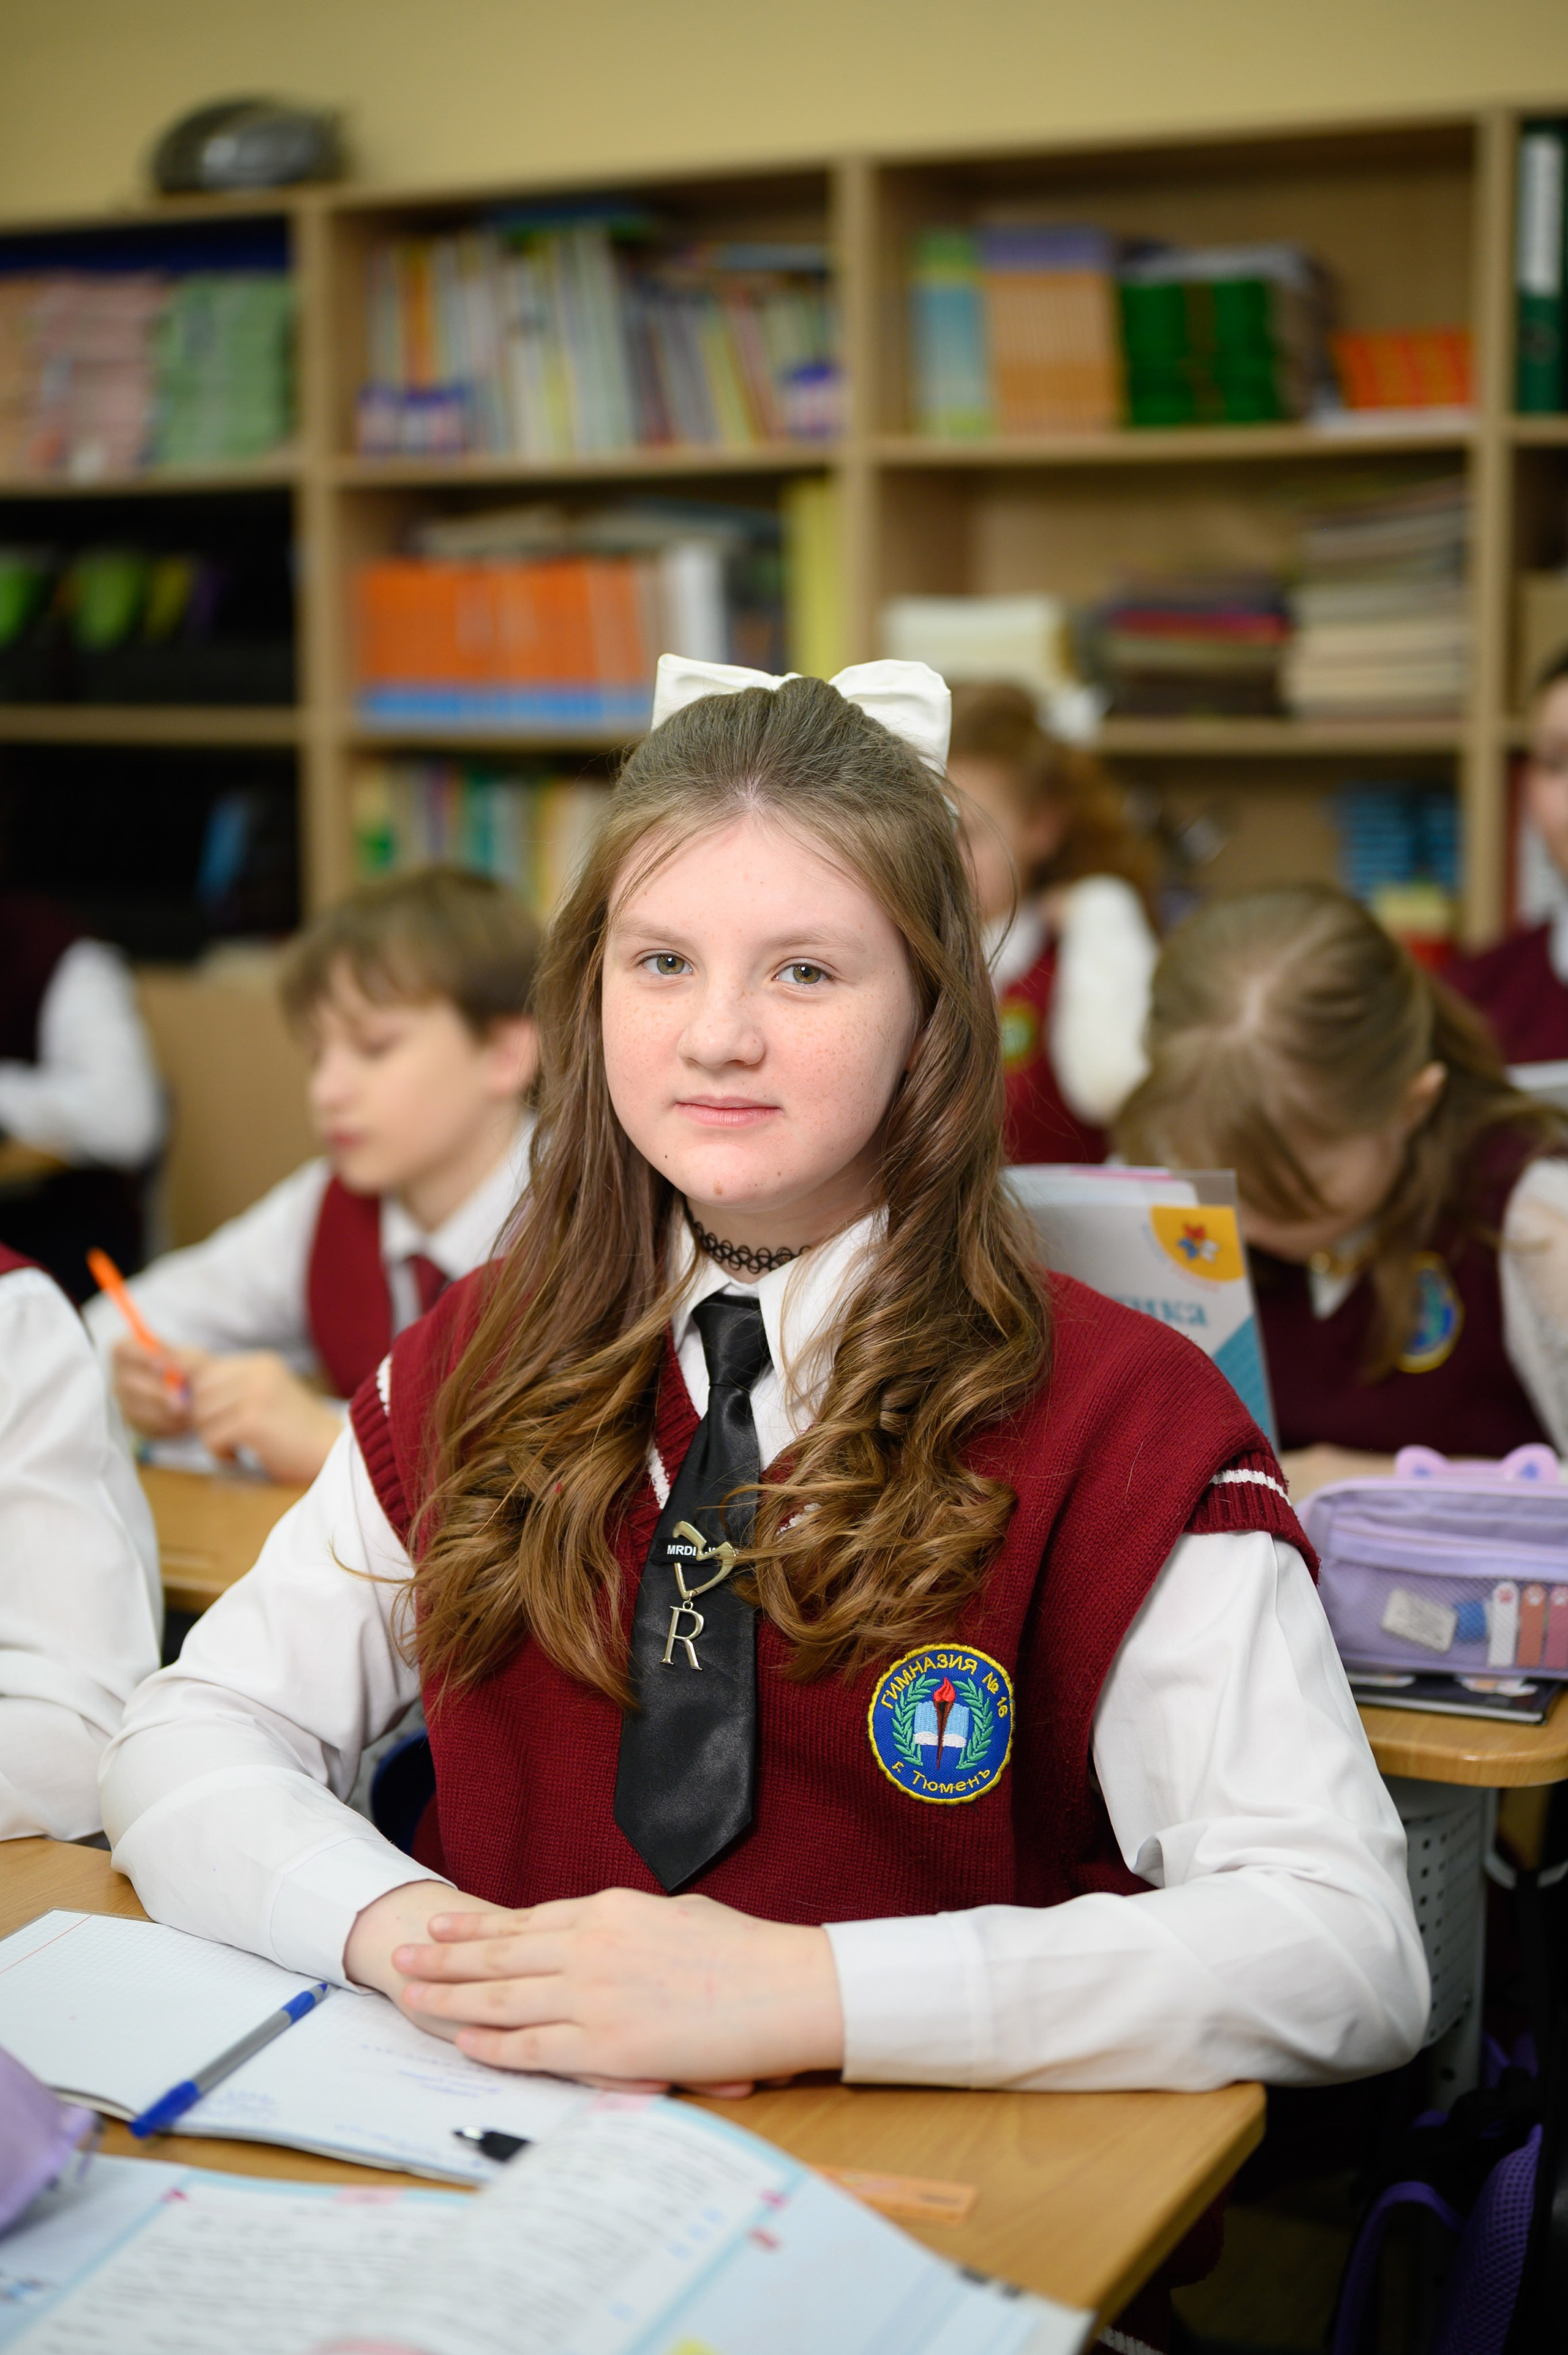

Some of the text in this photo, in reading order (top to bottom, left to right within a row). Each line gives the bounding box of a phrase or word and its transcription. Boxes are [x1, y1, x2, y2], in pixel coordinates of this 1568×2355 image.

[659, 1605, 704, 1671] R
[881, 1654, 978, 1709] ГИМНАЗИЯ
[913, 1769, 990, 1794] Тюмень
